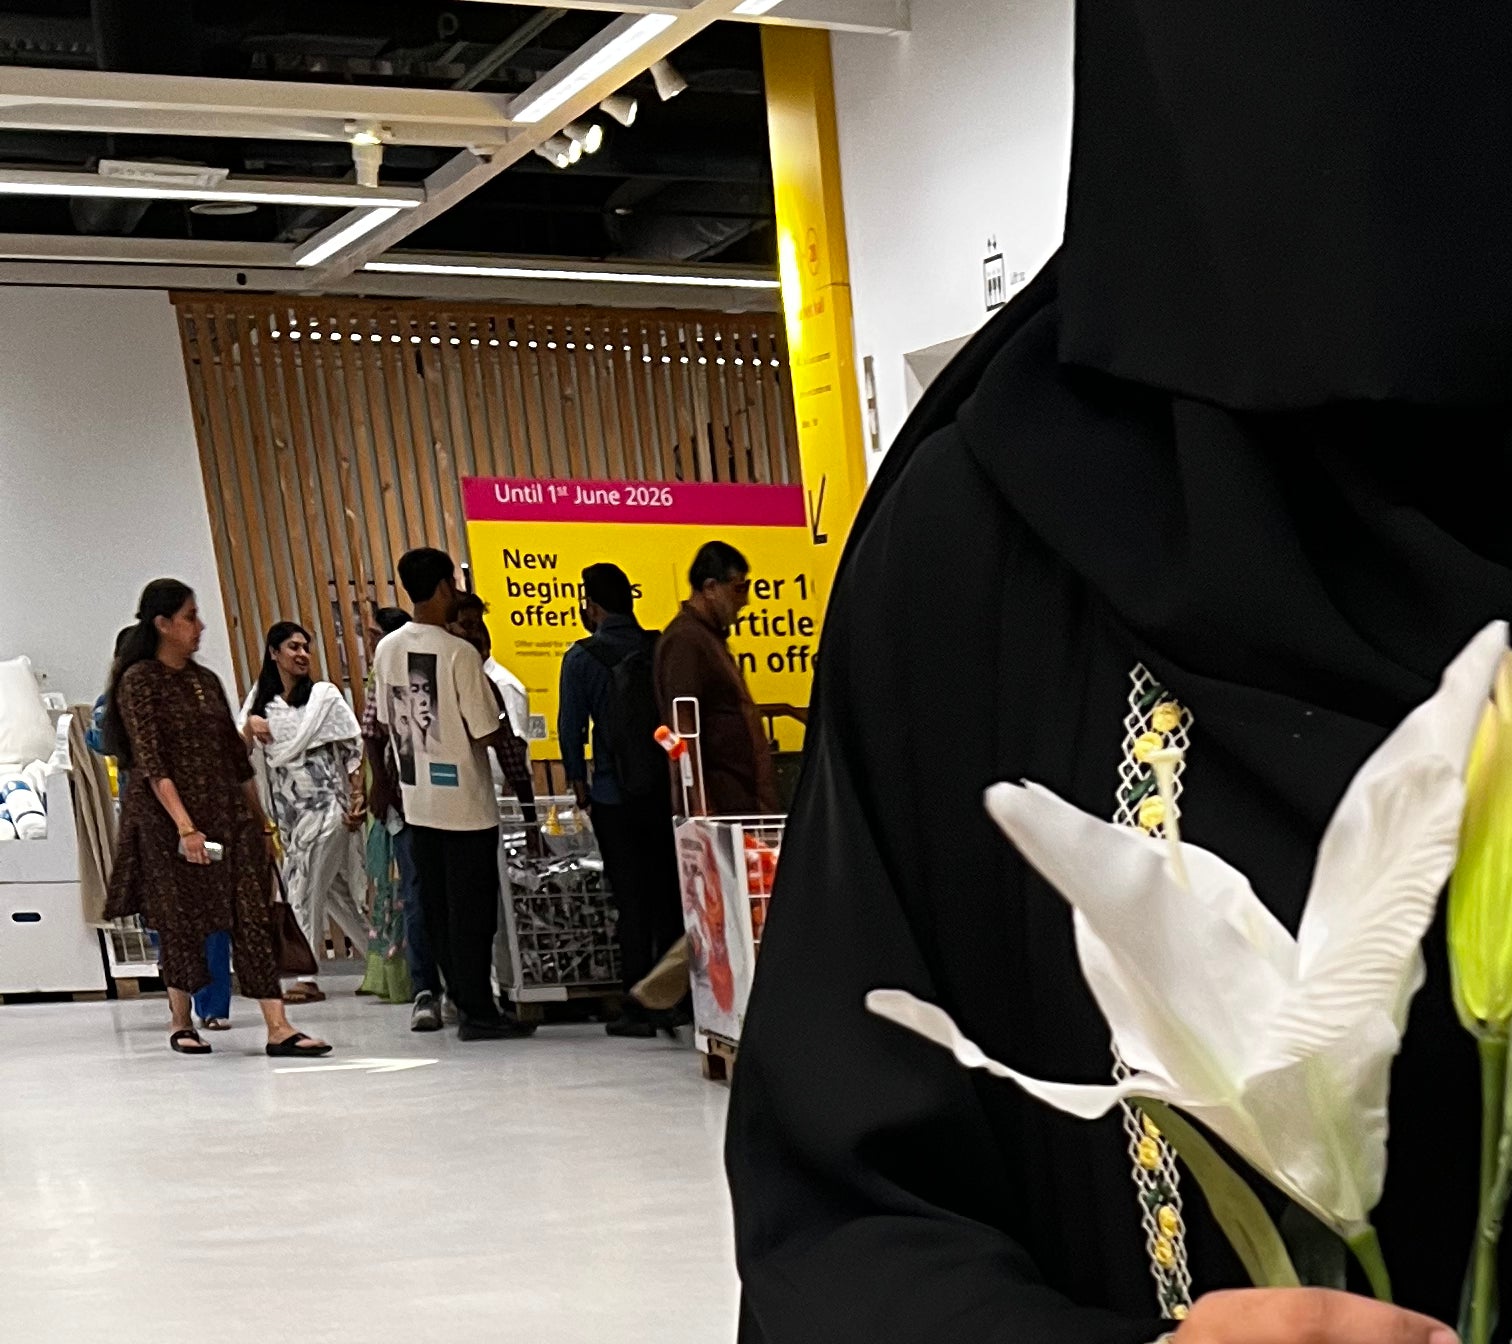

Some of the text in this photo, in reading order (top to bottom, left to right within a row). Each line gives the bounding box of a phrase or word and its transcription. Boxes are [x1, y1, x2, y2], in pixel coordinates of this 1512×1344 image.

[494, 483, 673, 506] Until 1st June 2026
[503, 549, 557, 569] New
[507, 576, 643, 604] begins
[746, 578, 785, 600] er
[511, 605, 577, 627] offer!
[735, 608, 814, 637] rticle
[739, 645, 817, 673] n off
